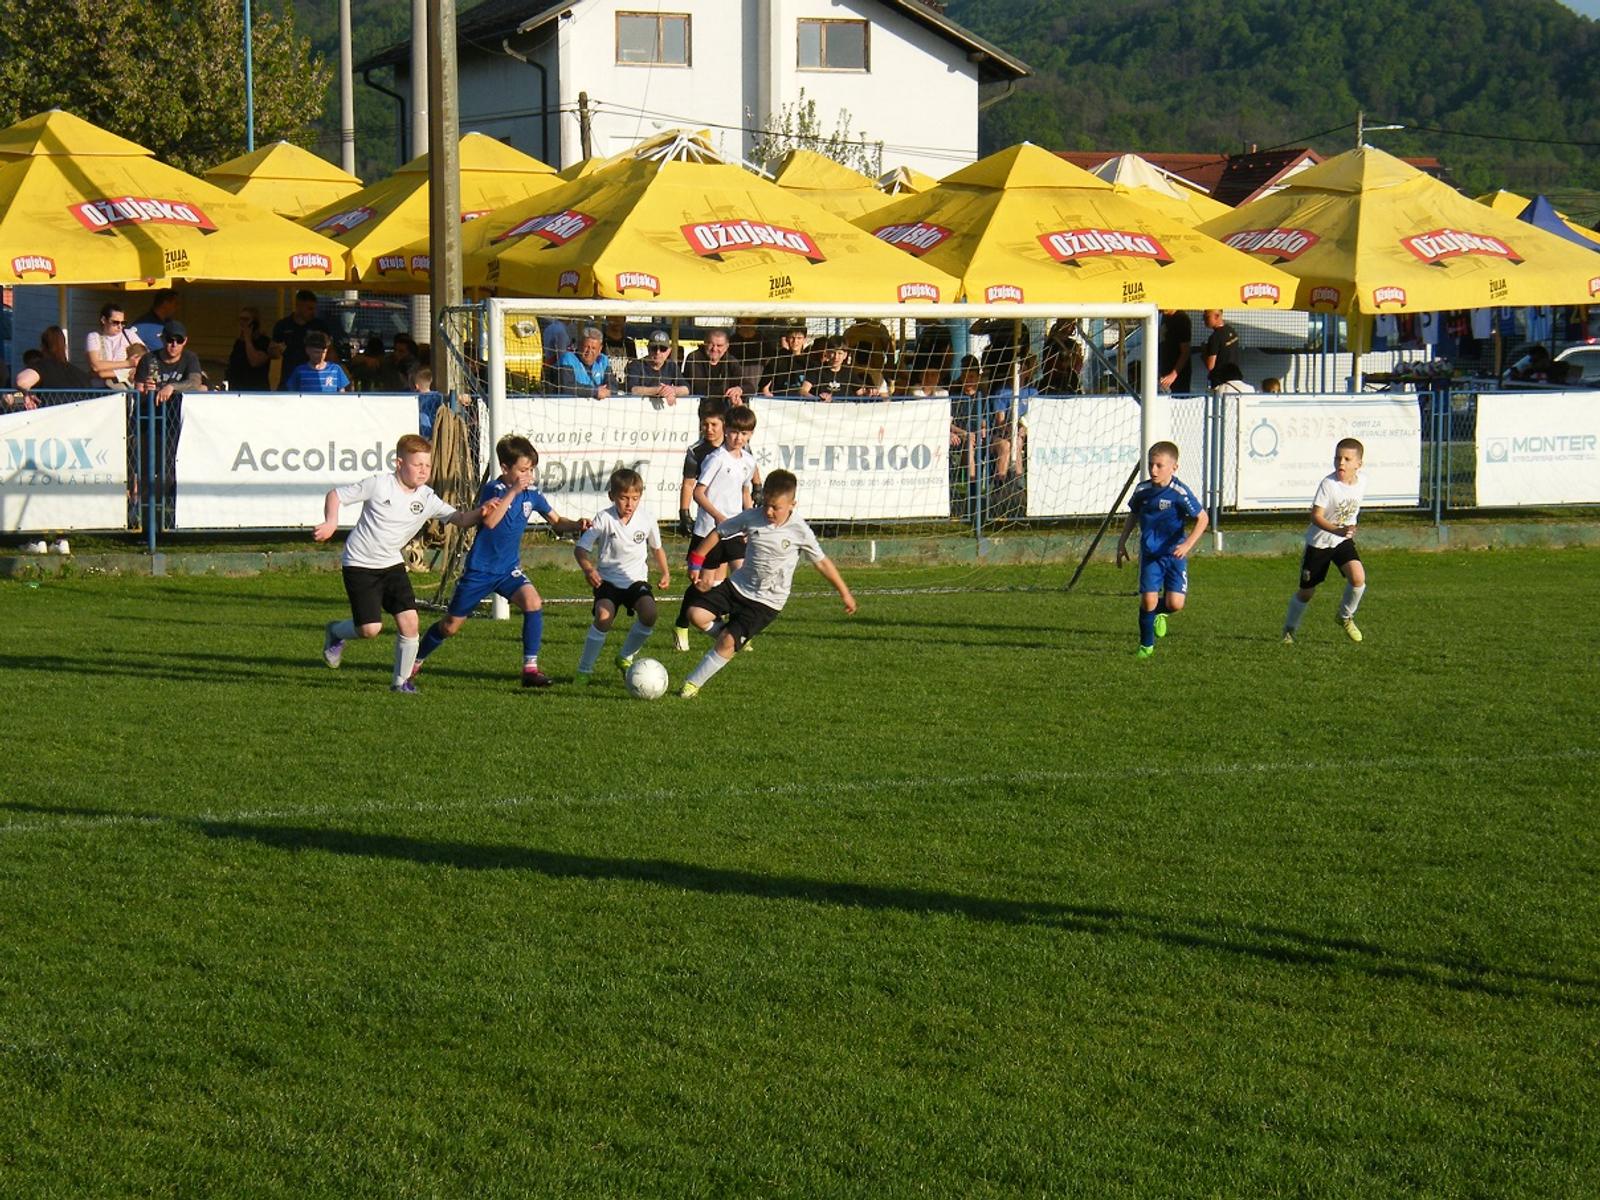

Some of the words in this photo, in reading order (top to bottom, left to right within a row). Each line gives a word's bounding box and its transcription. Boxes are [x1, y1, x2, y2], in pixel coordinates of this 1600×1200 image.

[81, 197, 200, 226] Ožujsko
[694, 221, 810, 250] Ožujsko
[1048, 230, 1158, 256] Ožujsko
[1410, 229, 1508, 258] Ožujsko
[15, 256, 52, 272] Ožujsko
[165, 248, 188, 264] ŽUJA
[292, 253, 328, 268] Ožujsko
[620, 273, 656, 289] Ožujsko
[769, 275, 792, 289] ŽUJA
[1123, 281, 1144, 296] ŽUJA
[901, 283, 936, 298] Ožujsko
[988, 285, 1021, 299] Ožujsko
[613, 429, 689, 446] trgovina
[1512, 434, 1597, 453] MONTER
[19, 473, 112, 486] IZOLATER
